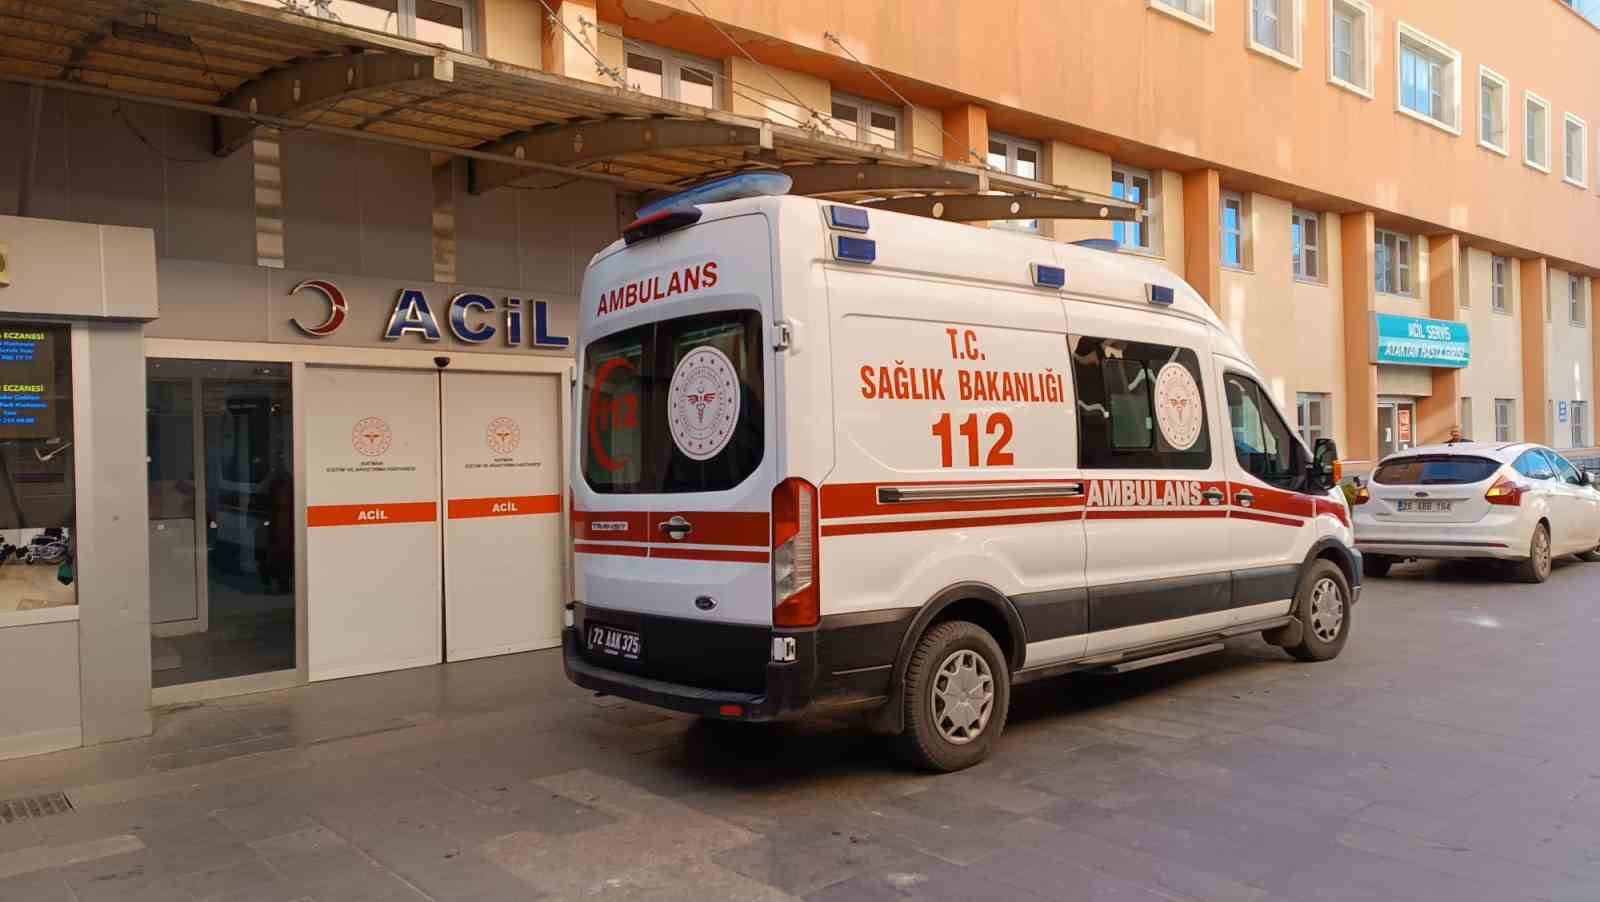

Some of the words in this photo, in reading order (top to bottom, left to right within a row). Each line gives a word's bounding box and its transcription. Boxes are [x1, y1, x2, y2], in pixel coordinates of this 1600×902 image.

[597, 261, 718, 317] AMBULANS
[946, 327, 986, 361] T.C.
[860, 360, 945, 401] SAĞLIK
[958, 368, 1065, 404] BAKANLIĞI
[931, 412, 1014, 468] 112
[492, 500, 519, 513] ACİL
[1086, 480, 1203, 507] AMBULANS
[358, 508, 389, 521] ACİL
[592, 628, 604, 645] 72
[605, 630, 622, 650] AAK
[622, 635, 640, 653] 375
